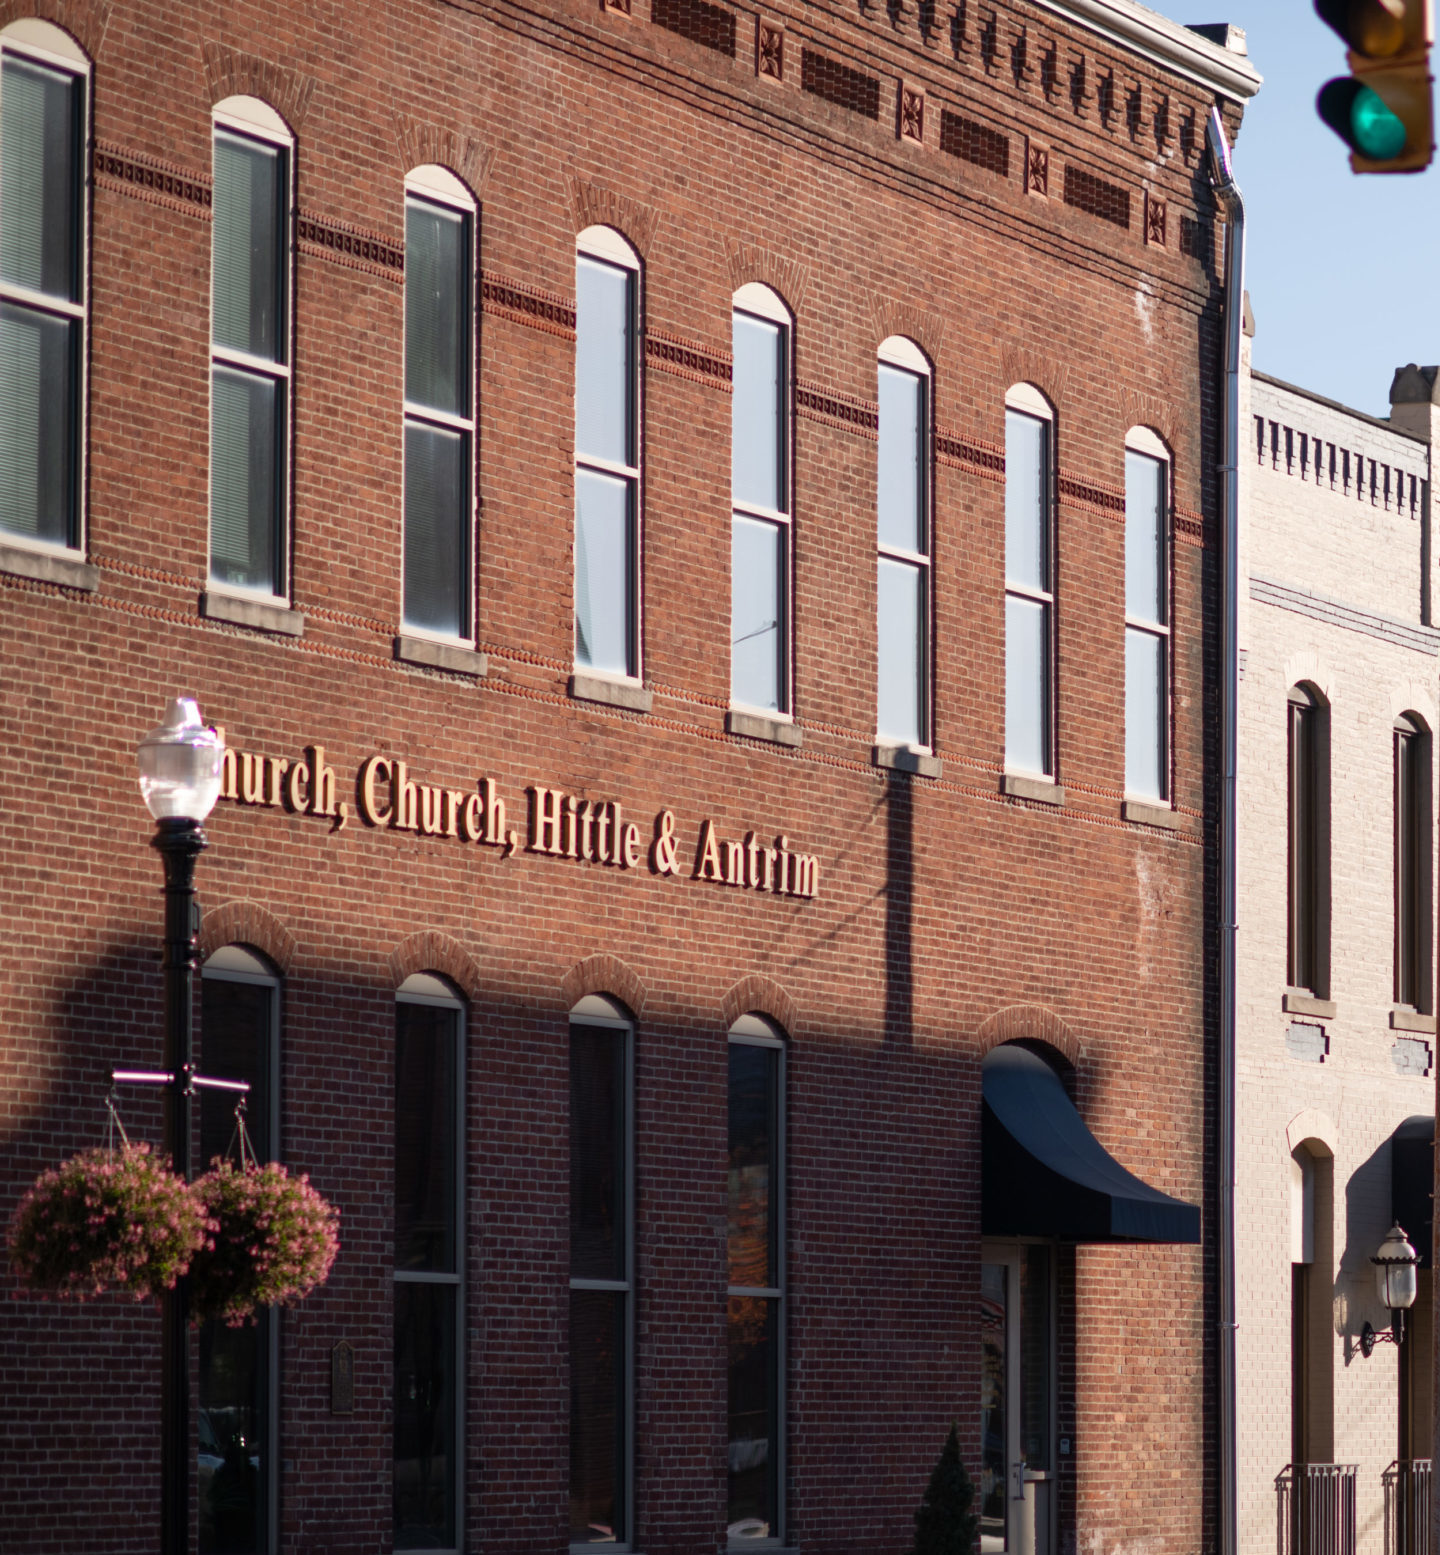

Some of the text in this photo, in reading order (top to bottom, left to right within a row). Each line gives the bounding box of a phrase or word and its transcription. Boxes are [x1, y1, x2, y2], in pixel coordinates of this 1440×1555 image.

[217, 726, 819, 898] hurch, Church, Hittle & Antrim
